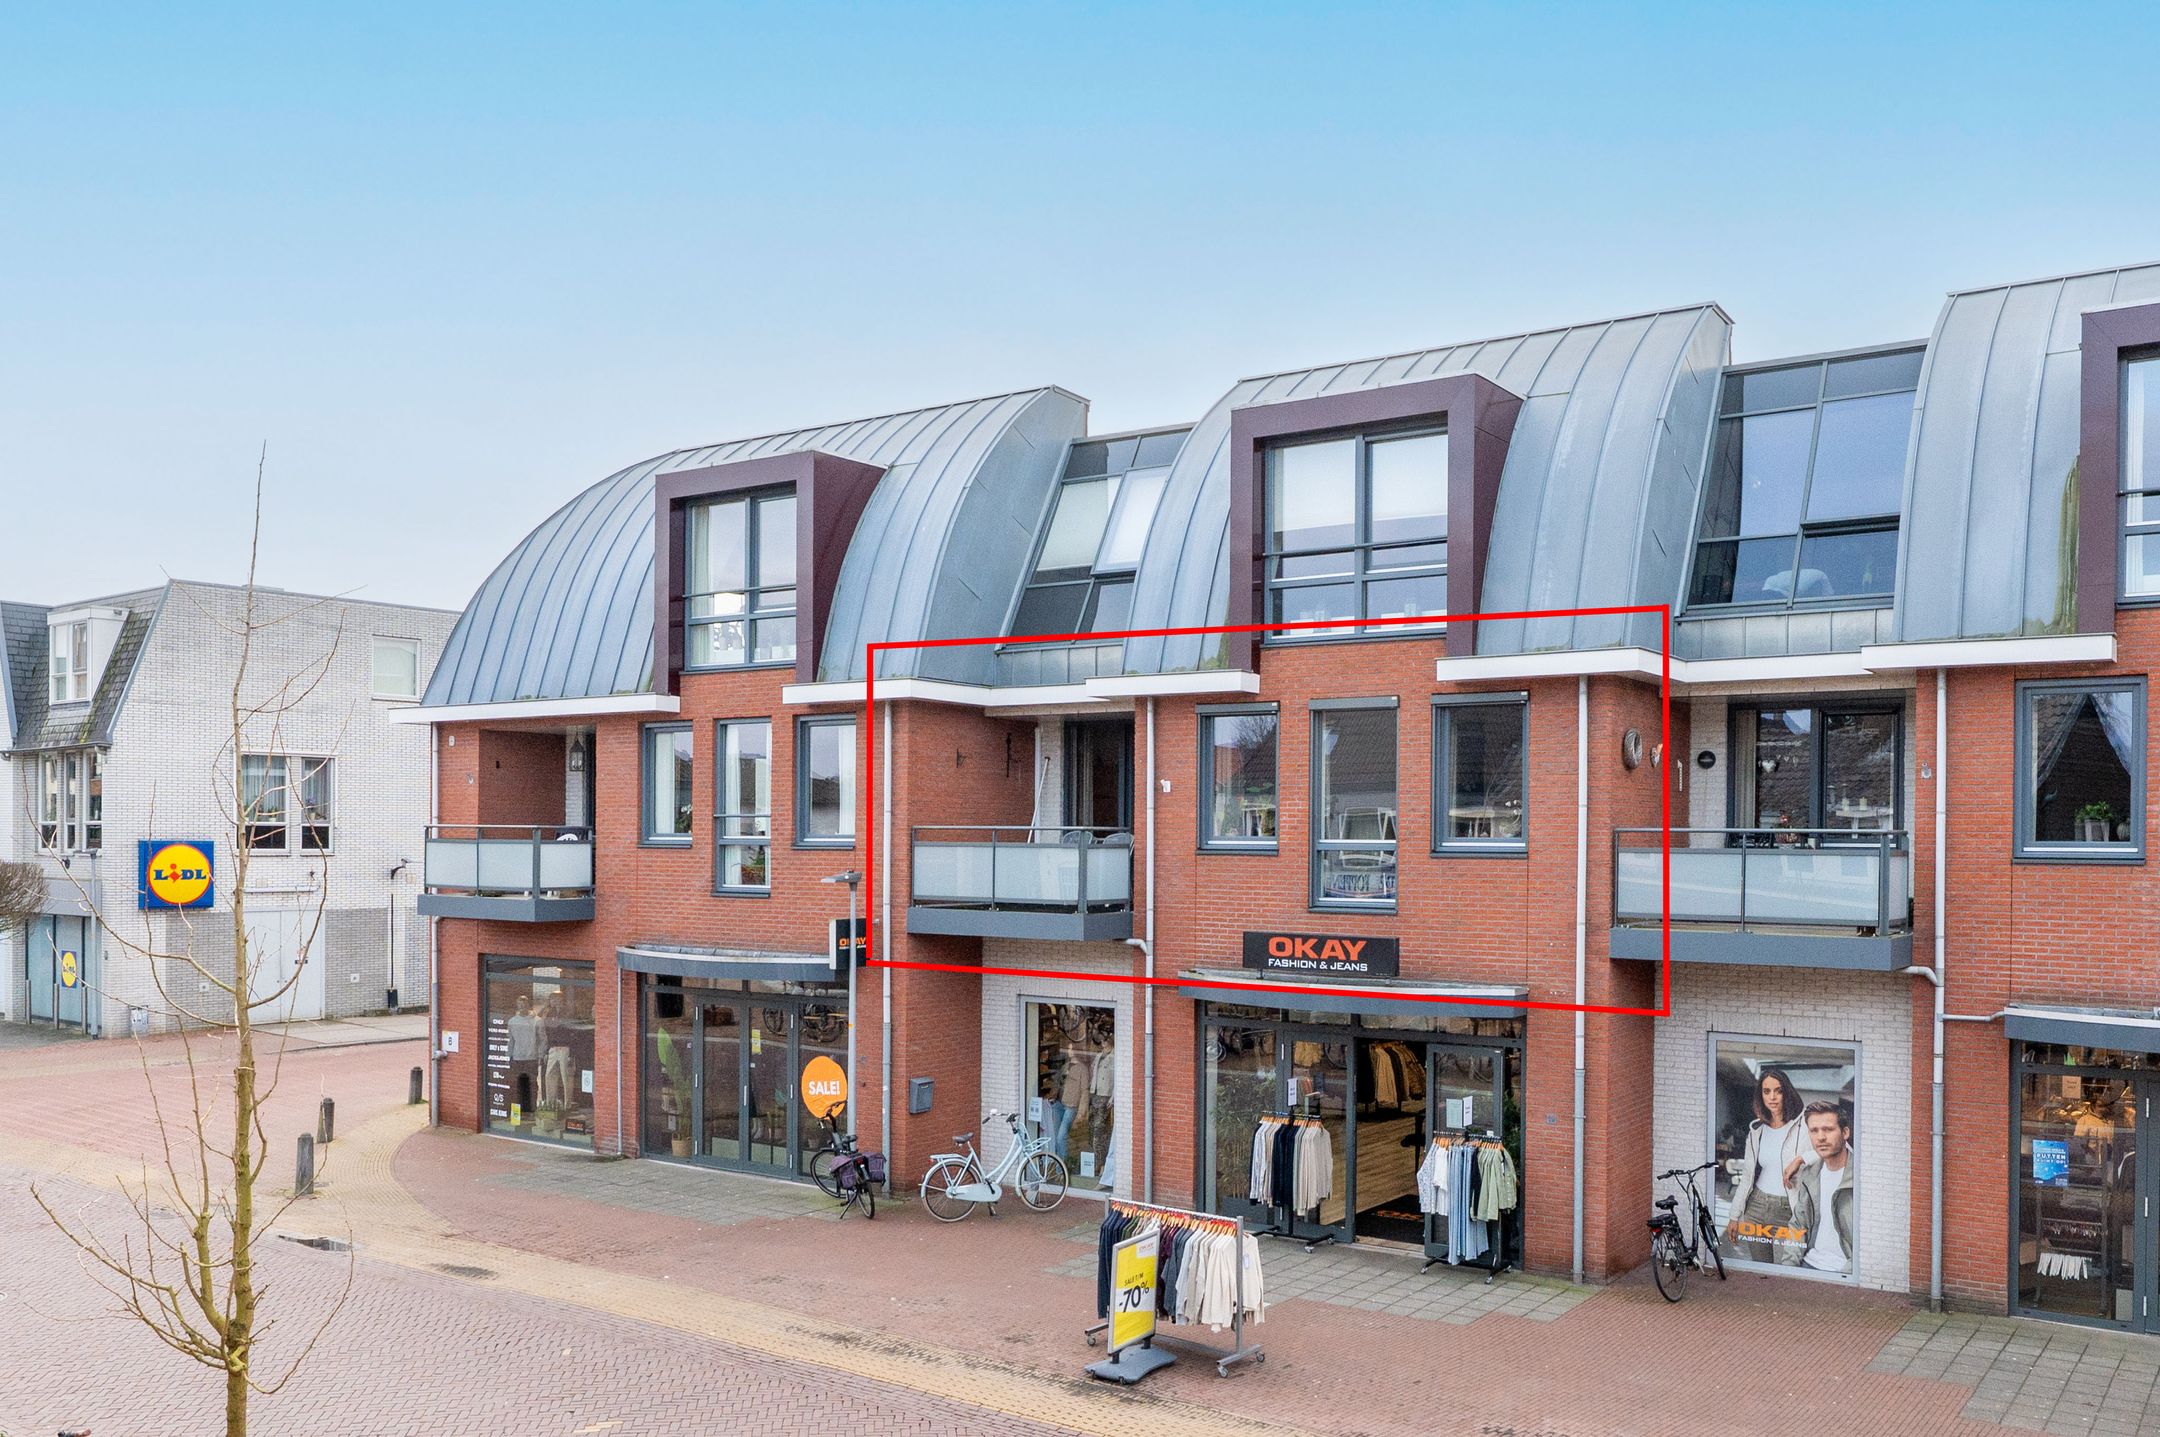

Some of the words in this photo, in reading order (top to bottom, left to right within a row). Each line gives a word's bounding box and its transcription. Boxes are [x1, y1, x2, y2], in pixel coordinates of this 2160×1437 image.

[1268, 936, 1367, 961] OKAY
[1268, 958, 1317, 969] FASHION
[1319, 961, 1328, 970] &
[1330, 962, 1368, 972] JEANS
[808, 1080, 841, 1096] SALE!
[2036, 1152, 2066, 1160] PUTTEN
[1738, 1234, 1773, 1244] FASHION
[1739, 1222, 1808, 1242] OKAY
[1124, 1276, 1135, 1287] SALE
[1119, 1281, 1150, 1314] -70%
